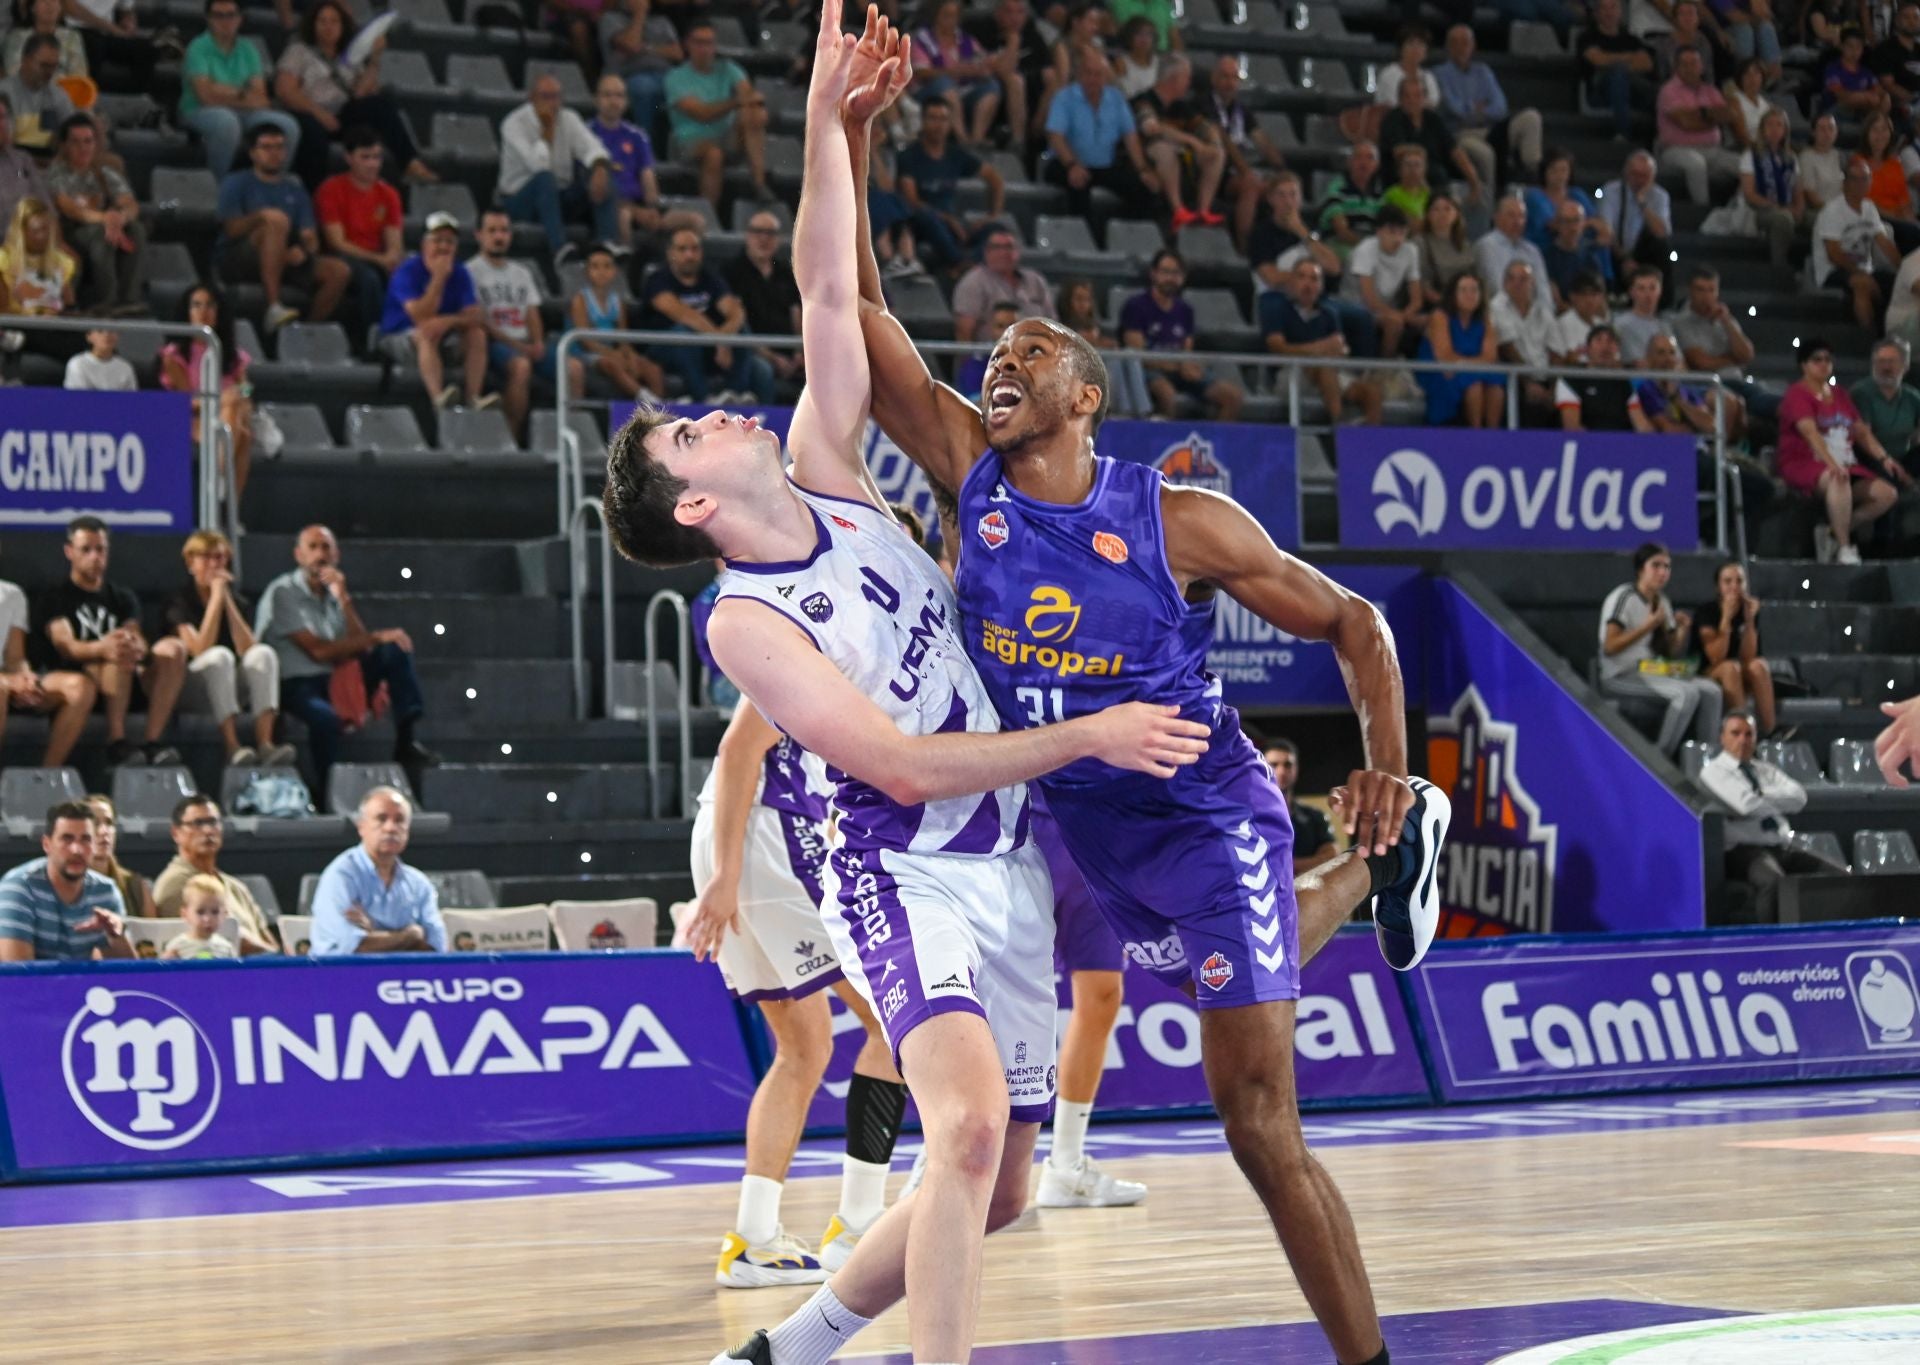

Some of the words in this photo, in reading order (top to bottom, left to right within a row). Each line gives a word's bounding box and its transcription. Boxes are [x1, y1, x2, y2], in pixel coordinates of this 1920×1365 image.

[1, 430, 145, 493] CAMPO
[1461, 441, 1667, 531] ovlac
[982, 619, 1018, 639] super
[982, 630, 1123, 677] agropal
[1206, 650, 1294, 667] MIENTO
[1016, 687, 1065, 730] 31
[1202, 964, 1231, 980] PALENCIA
[1737, 963, 1840, 985] autoservicios
[377, 978, 523, 1004] GRUPO
[882, 978, 907, 1020] CBC
[1792, 984, 1846, 1002] ahorro
[231, 1004, 691, 1085] INMAPA
